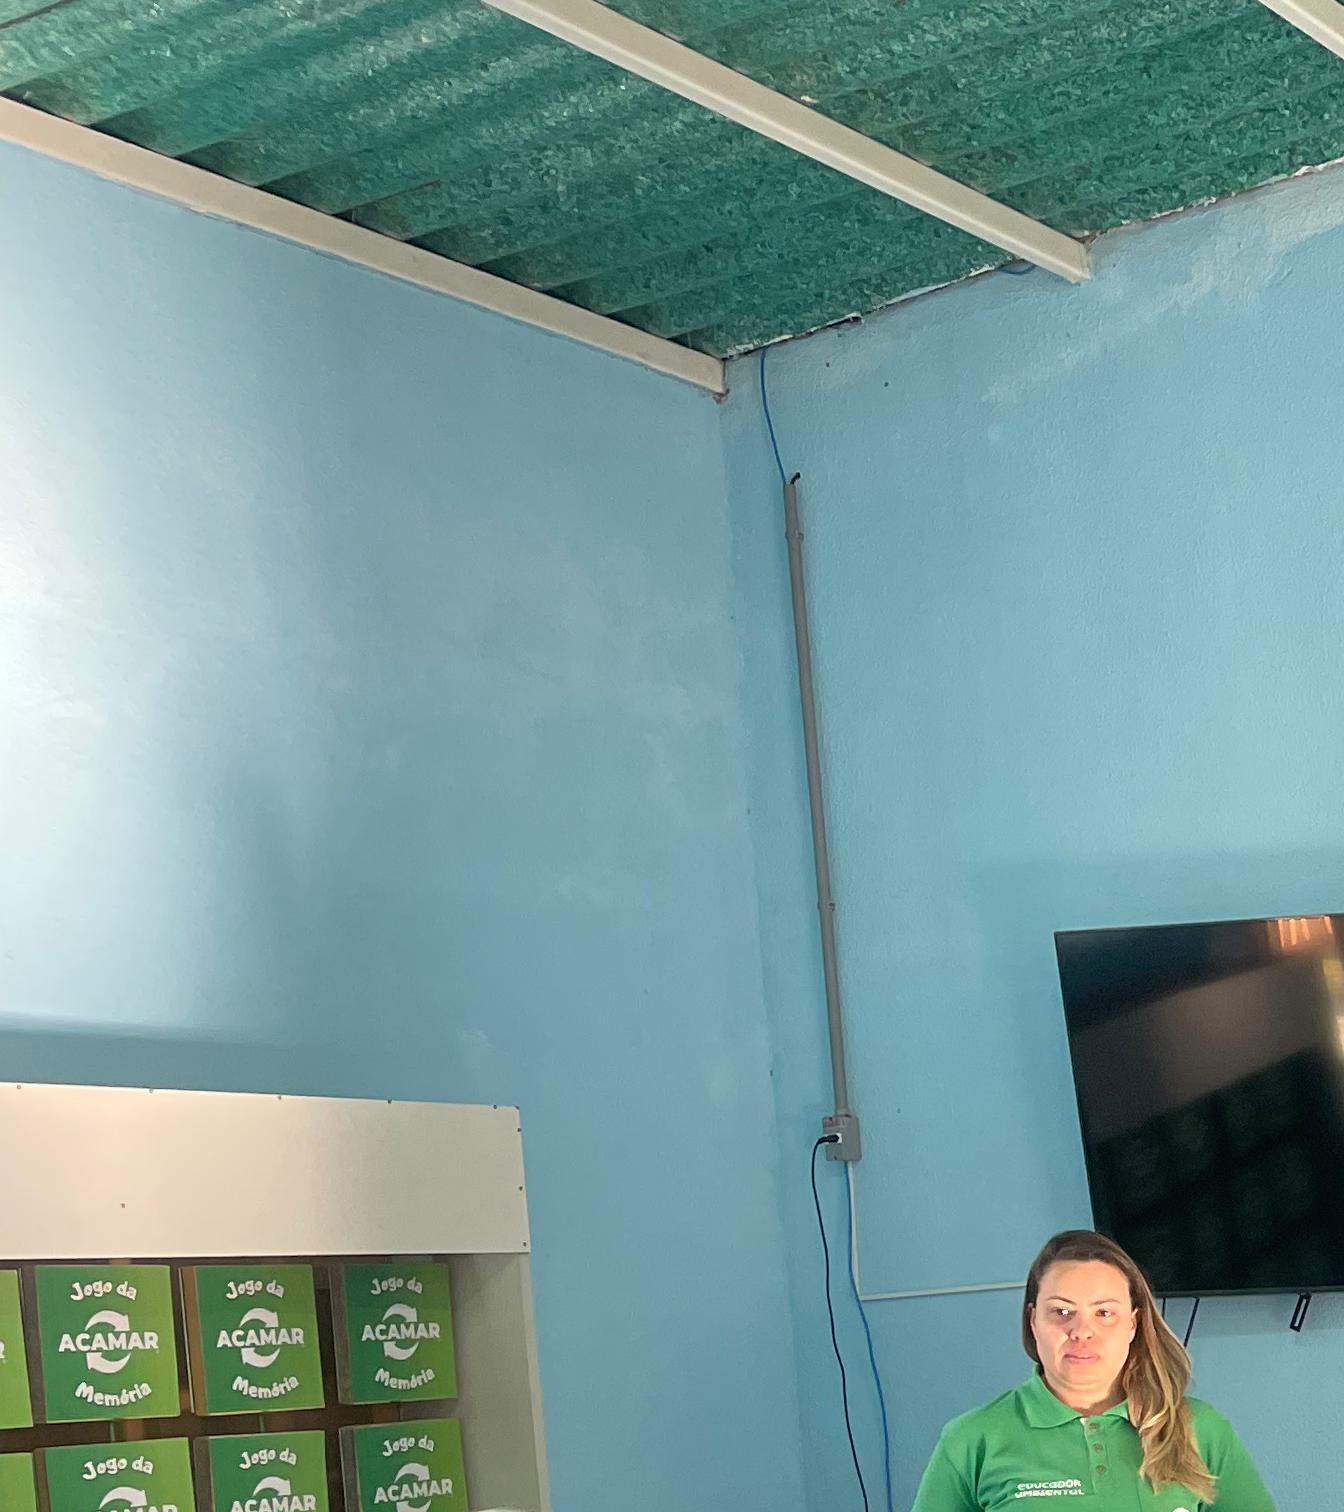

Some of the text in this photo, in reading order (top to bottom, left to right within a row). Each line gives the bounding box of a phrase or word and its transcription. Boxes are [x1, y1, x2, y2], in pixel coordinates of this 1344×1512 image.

[70, 1280, 137, 1301] Jogo da
[226, 1279, 284, 1299] Jogo da
[371, 1276, 422, 1295] Jogo da
[59, 1332, 159, 1352] ACAMAR
[217, 1328, 304, 1348] ACAMAR
[361, 1322, 440, 1342] ACAMAR
[75, 1382, 152, 1406] Memória
[382, 1435, 434, 1456] Jogo da
[82, 1456, 153, 1480] Jogo da
[239, 1447, 297, 1469] Jogo da
[374, 1478, 452, 1504] ACAMAR
